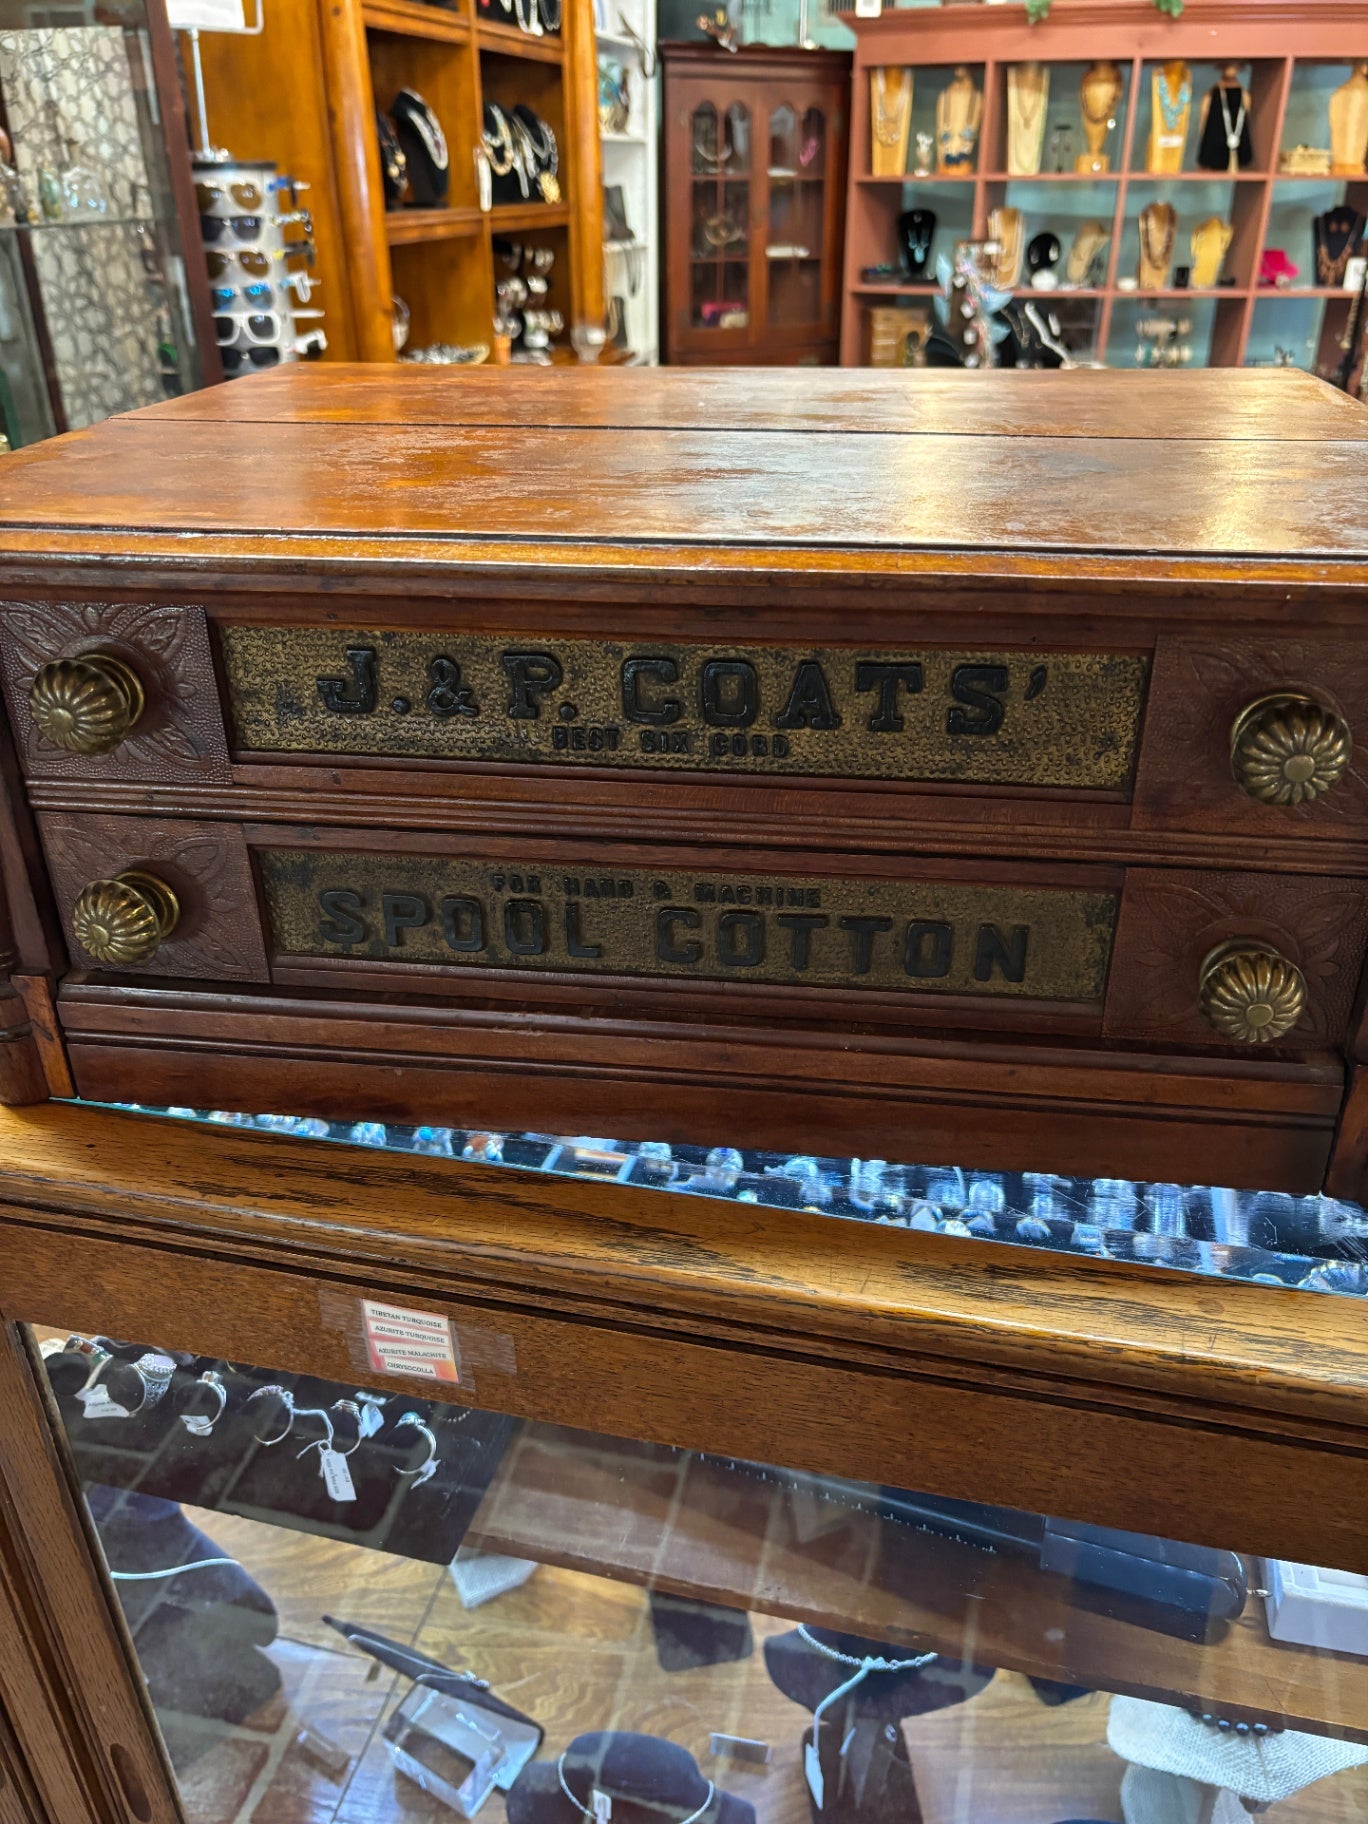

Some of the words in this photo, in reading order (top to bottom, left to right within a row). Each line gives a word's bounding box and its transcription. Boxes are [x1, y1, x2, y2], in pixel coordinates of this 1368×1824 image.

[316, 645, 408, 714] J.
[428, 655, 479, 717] &
[502, 650, 577, 722] P.
[552, 725, 620, 751] BEST
[640, 729, 688, 754] SIX
[712, 732, 789, 758] CORD
[491, 873, 541, 895] FOR
[563, 875, 634, 899] HAND
[694, 881, 822, 909] MACHINE
[318, 889, 601, 959] SPOOL
[656, 906, 1030, 983] COTTON
[371, 1309, 401, 1321] TIBETAN
[402, 1315, 442, 1329] TURQUOISE
[375, 1325, 405, 1336] AZURITE
[405, 1331, 445, 1344] TURQUOISE
[379, 1347, 408, 1356] AZURITE
[408, 1349, 447, 1359] MALACHITE
[387, 1361, 434, 1374] CHRYSOCOLLA
